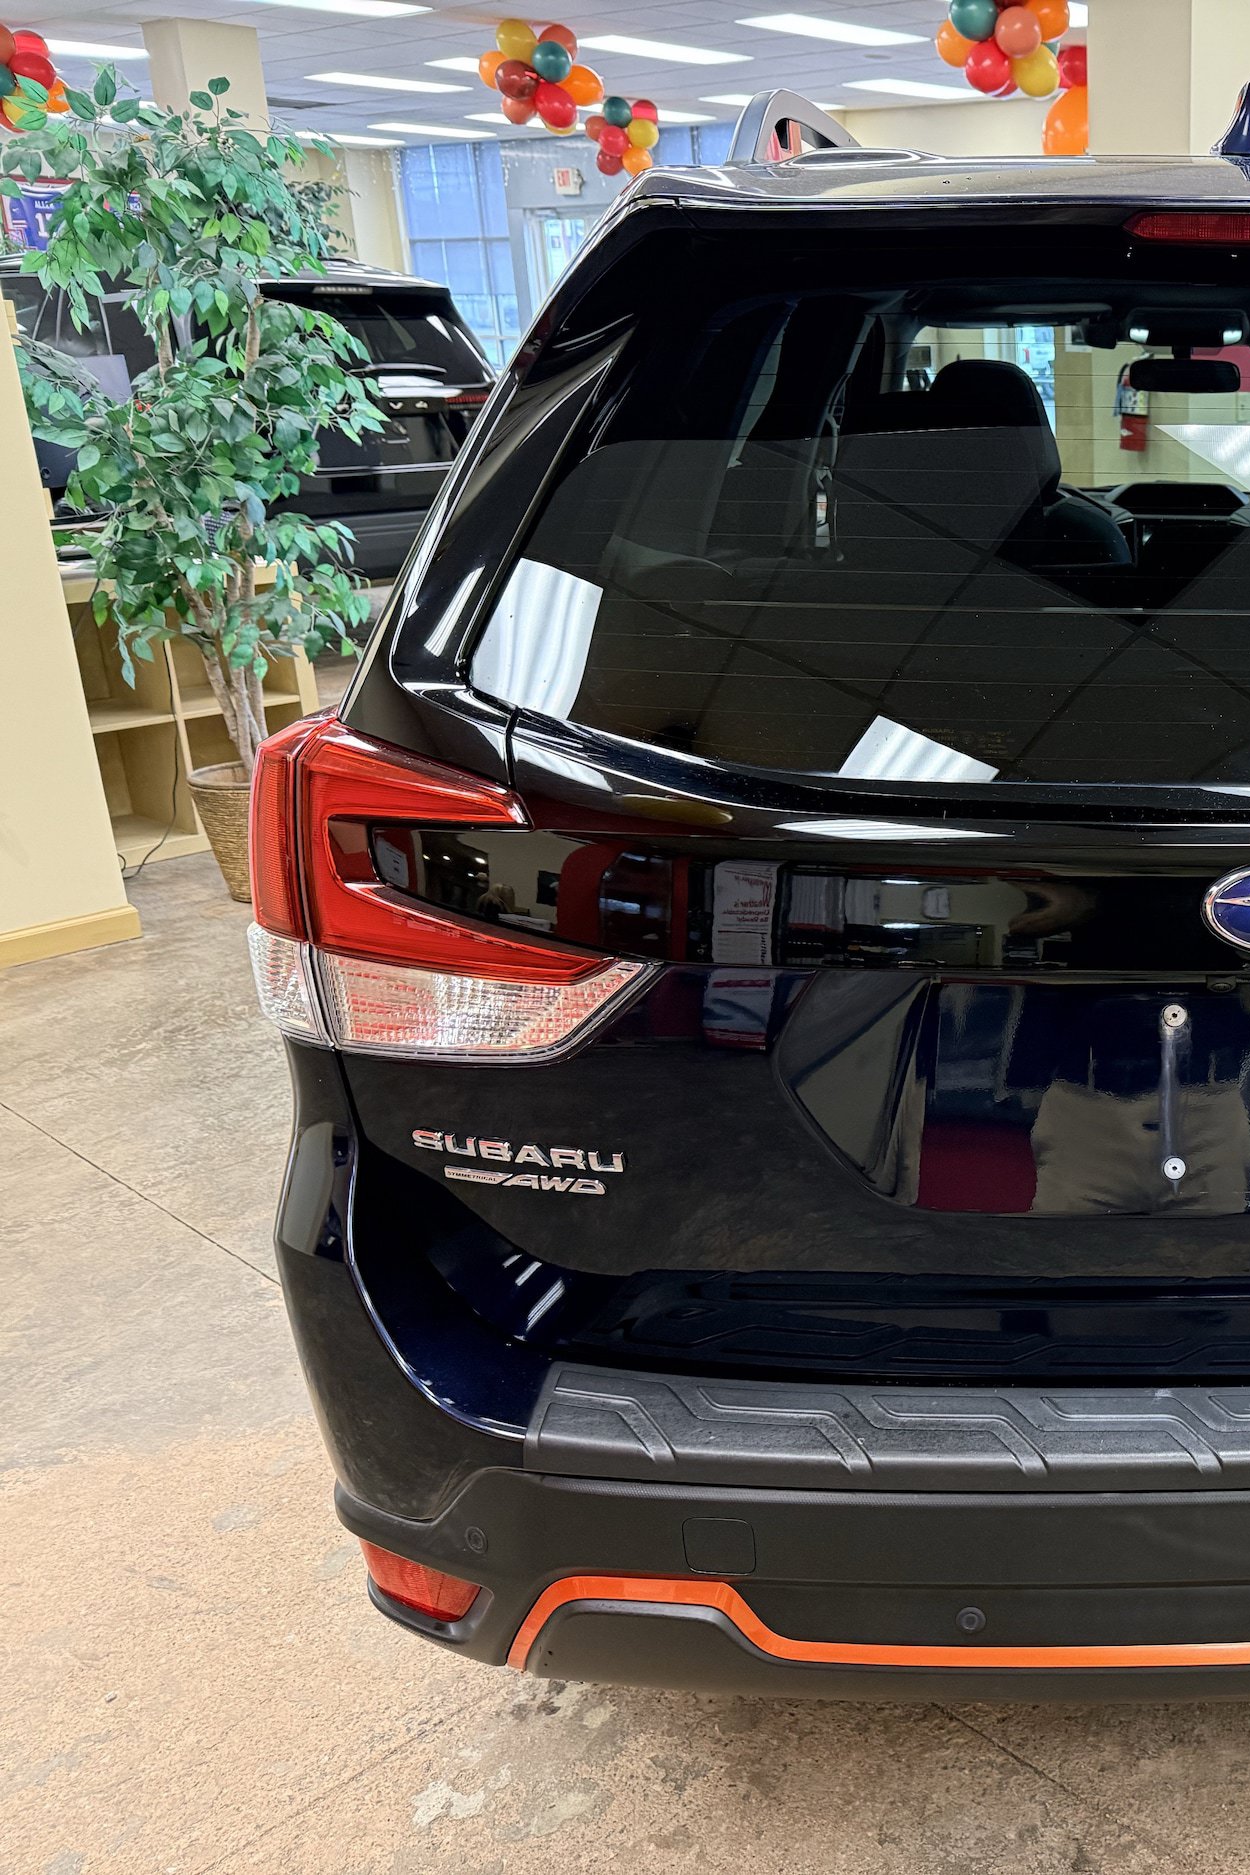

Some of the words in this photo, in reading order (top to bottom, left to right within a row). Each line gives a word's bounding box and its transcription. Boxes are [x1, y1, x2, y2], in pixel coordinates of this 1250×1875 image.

[412, 1129, 626, 1173] SUBARU
[447, 1171, 499, 1183] SYMMETRICAL
[503, 1174, 606, 1195] AWD
